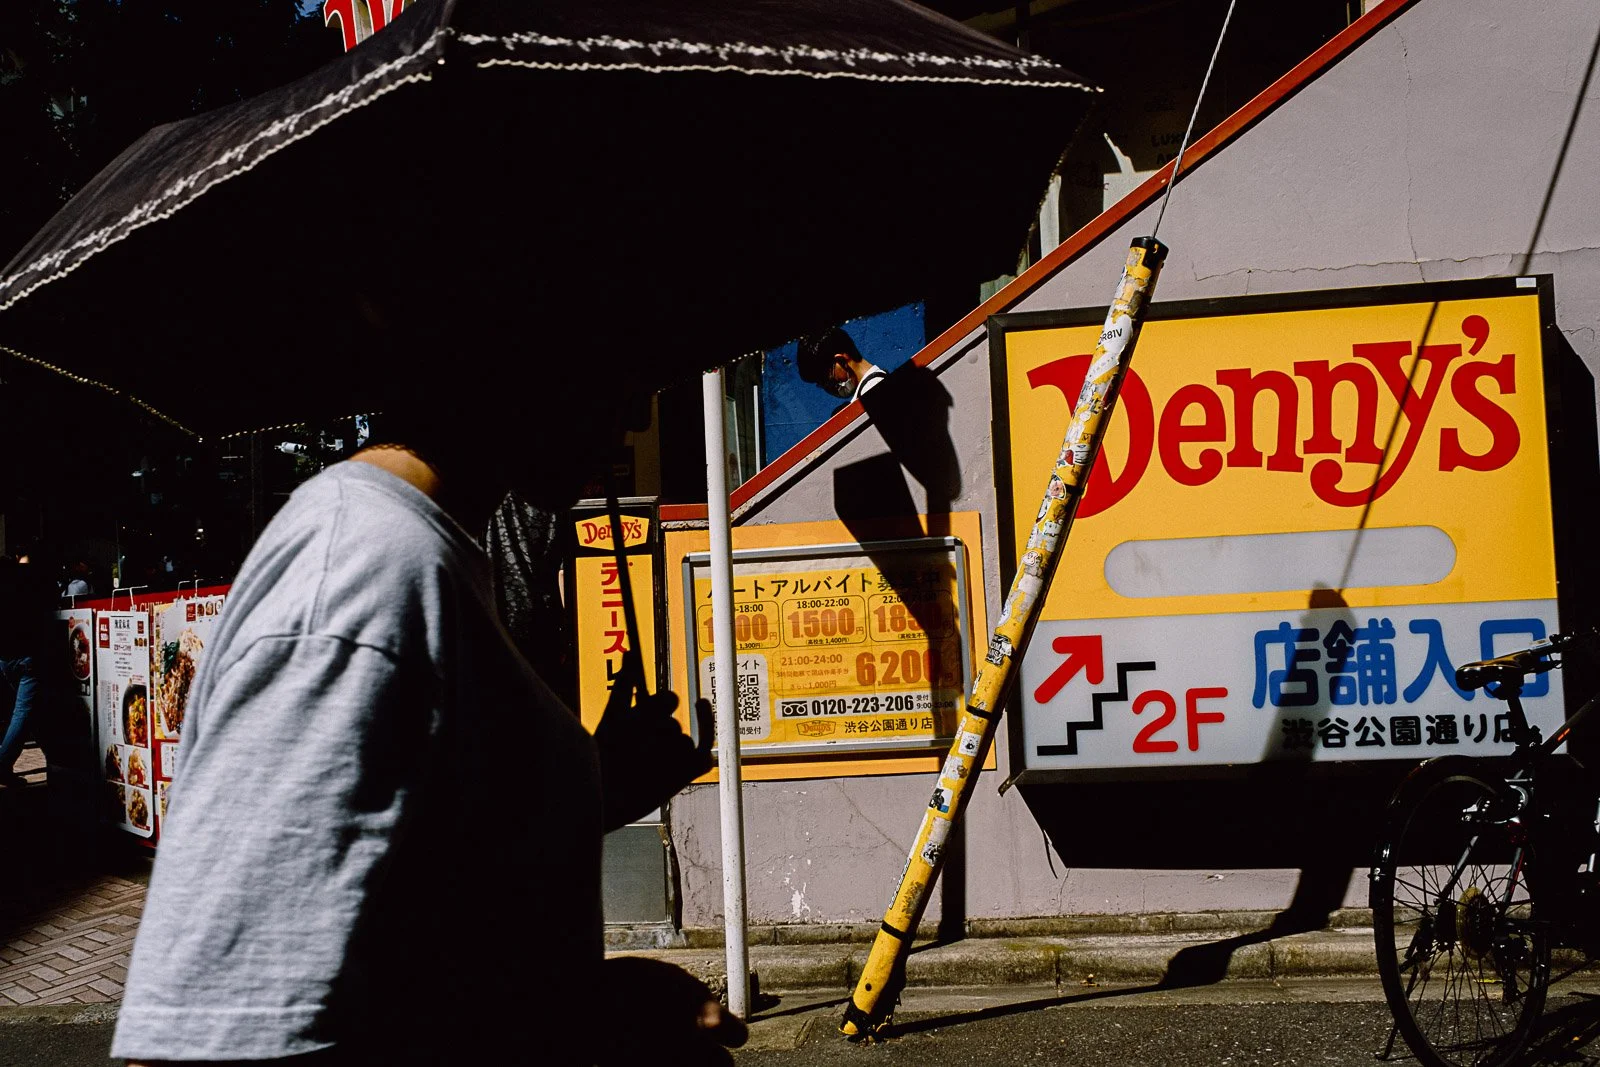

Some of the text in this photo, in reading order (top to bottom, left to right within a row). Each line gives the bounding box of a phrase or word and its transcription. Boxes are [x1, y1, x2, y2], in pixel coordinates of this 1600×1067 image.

[1027, 315, 1521, 518] Denny's
[797, 598, 850, 609] 18:00-22:00
[781, 653, 843, 666] 21:00-24:00
[1252, 617, 1549, 708] 店舗入口
[812, 695, 914, 716] 0120-223-206
[844, 717, 933, 734] 渋谷公園通り店
[1132, 687, 1228, 753] 2F
